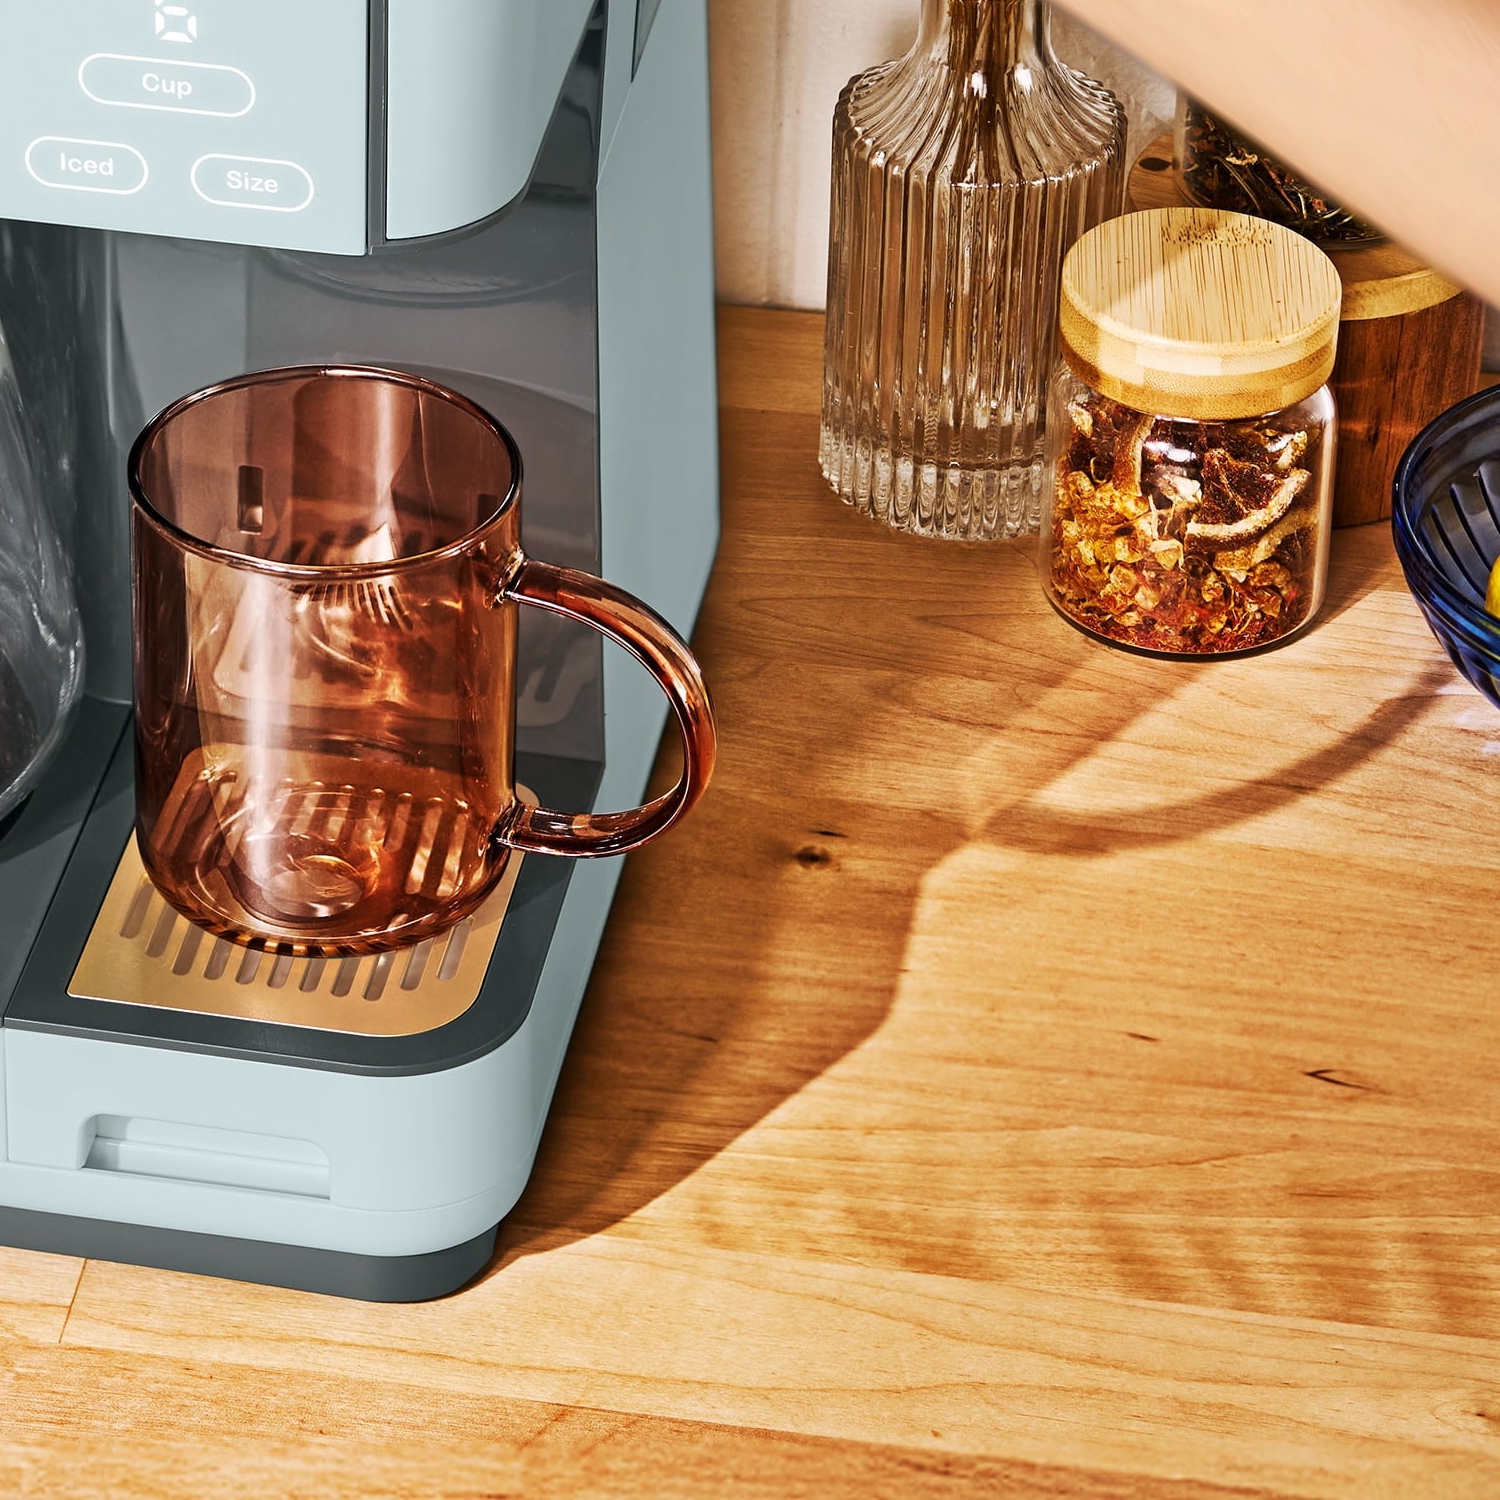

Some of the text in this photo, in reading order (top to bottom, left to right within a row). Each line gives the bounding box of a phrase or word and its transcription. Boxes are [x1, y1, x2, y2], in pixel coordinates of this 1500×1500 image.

[141, 72, 194, 100] Cup
[59, 152, 115, 178] Iced
[226, 169, 280, 196] Size
